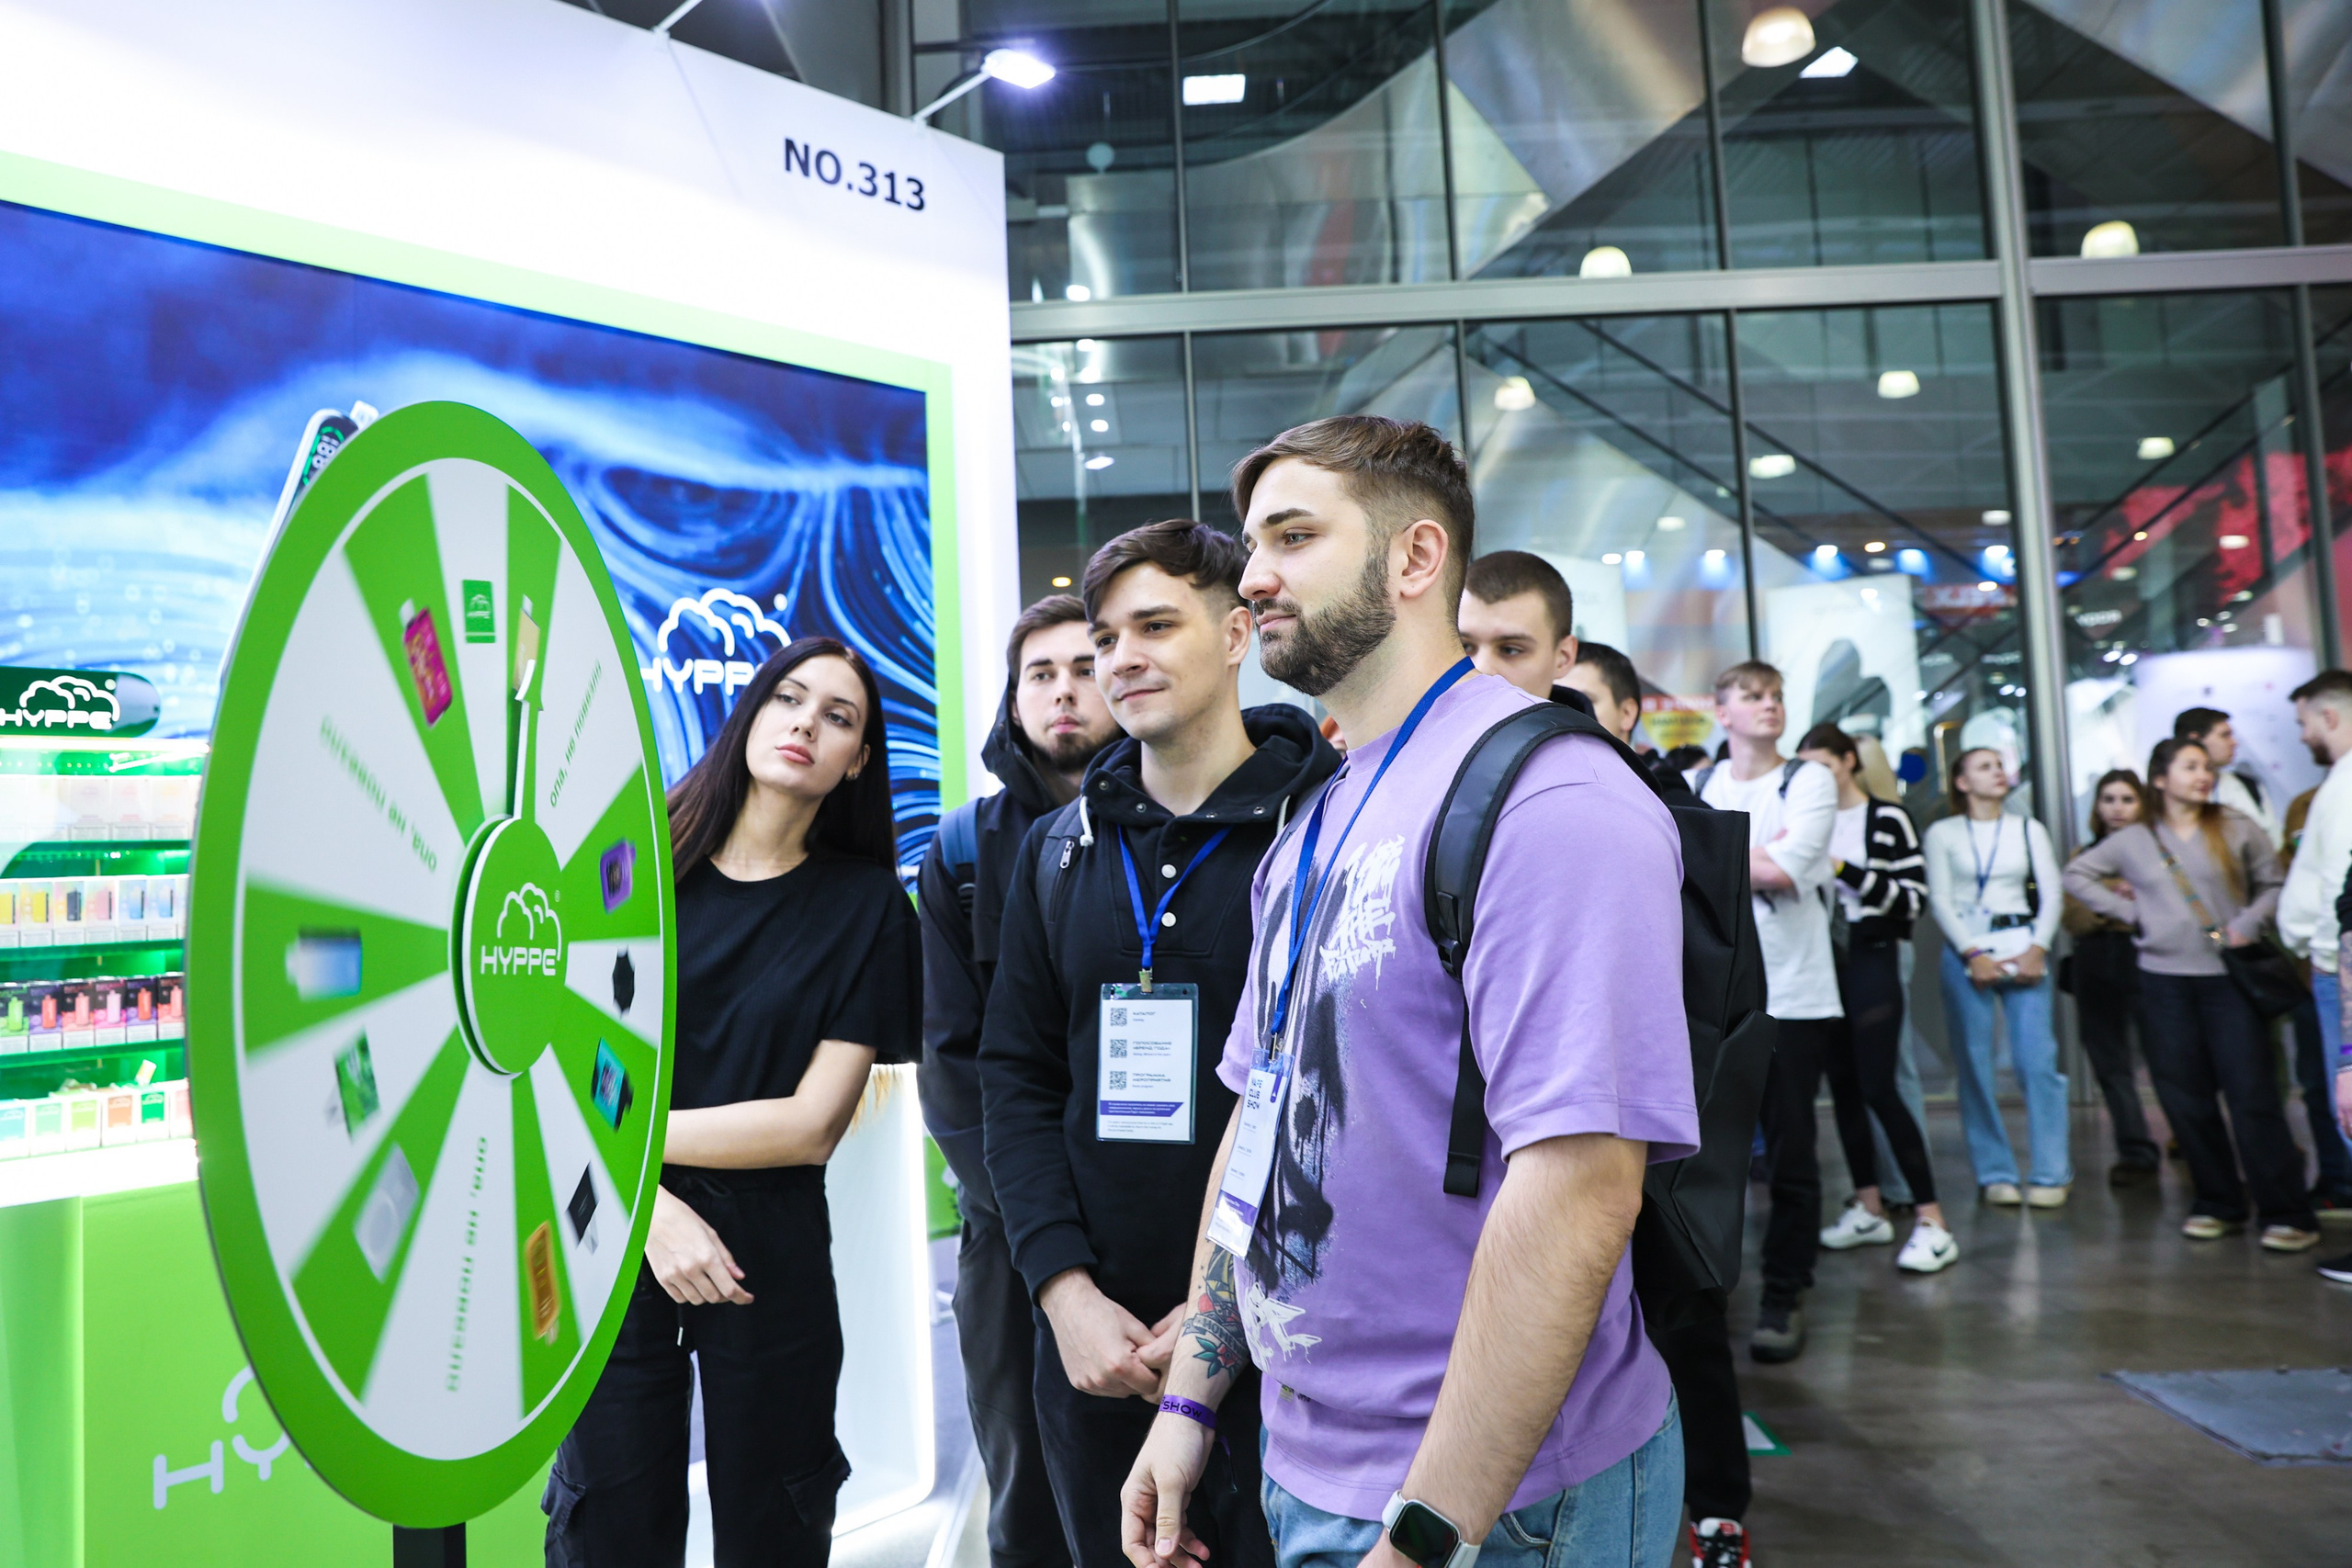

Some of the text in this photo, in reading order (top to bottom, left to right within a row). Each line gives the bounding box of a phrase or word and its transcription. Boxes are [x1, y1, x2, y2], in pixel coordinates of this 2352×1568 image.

[785, 138, 925, 211] NO.313
[640, 657, 763, 695] HYPP
[0, 708, 112, 730] HYPPE
[481, 945, 557, 976] HYPPE
[1162, 1401, 1204, 1419] SHOW
